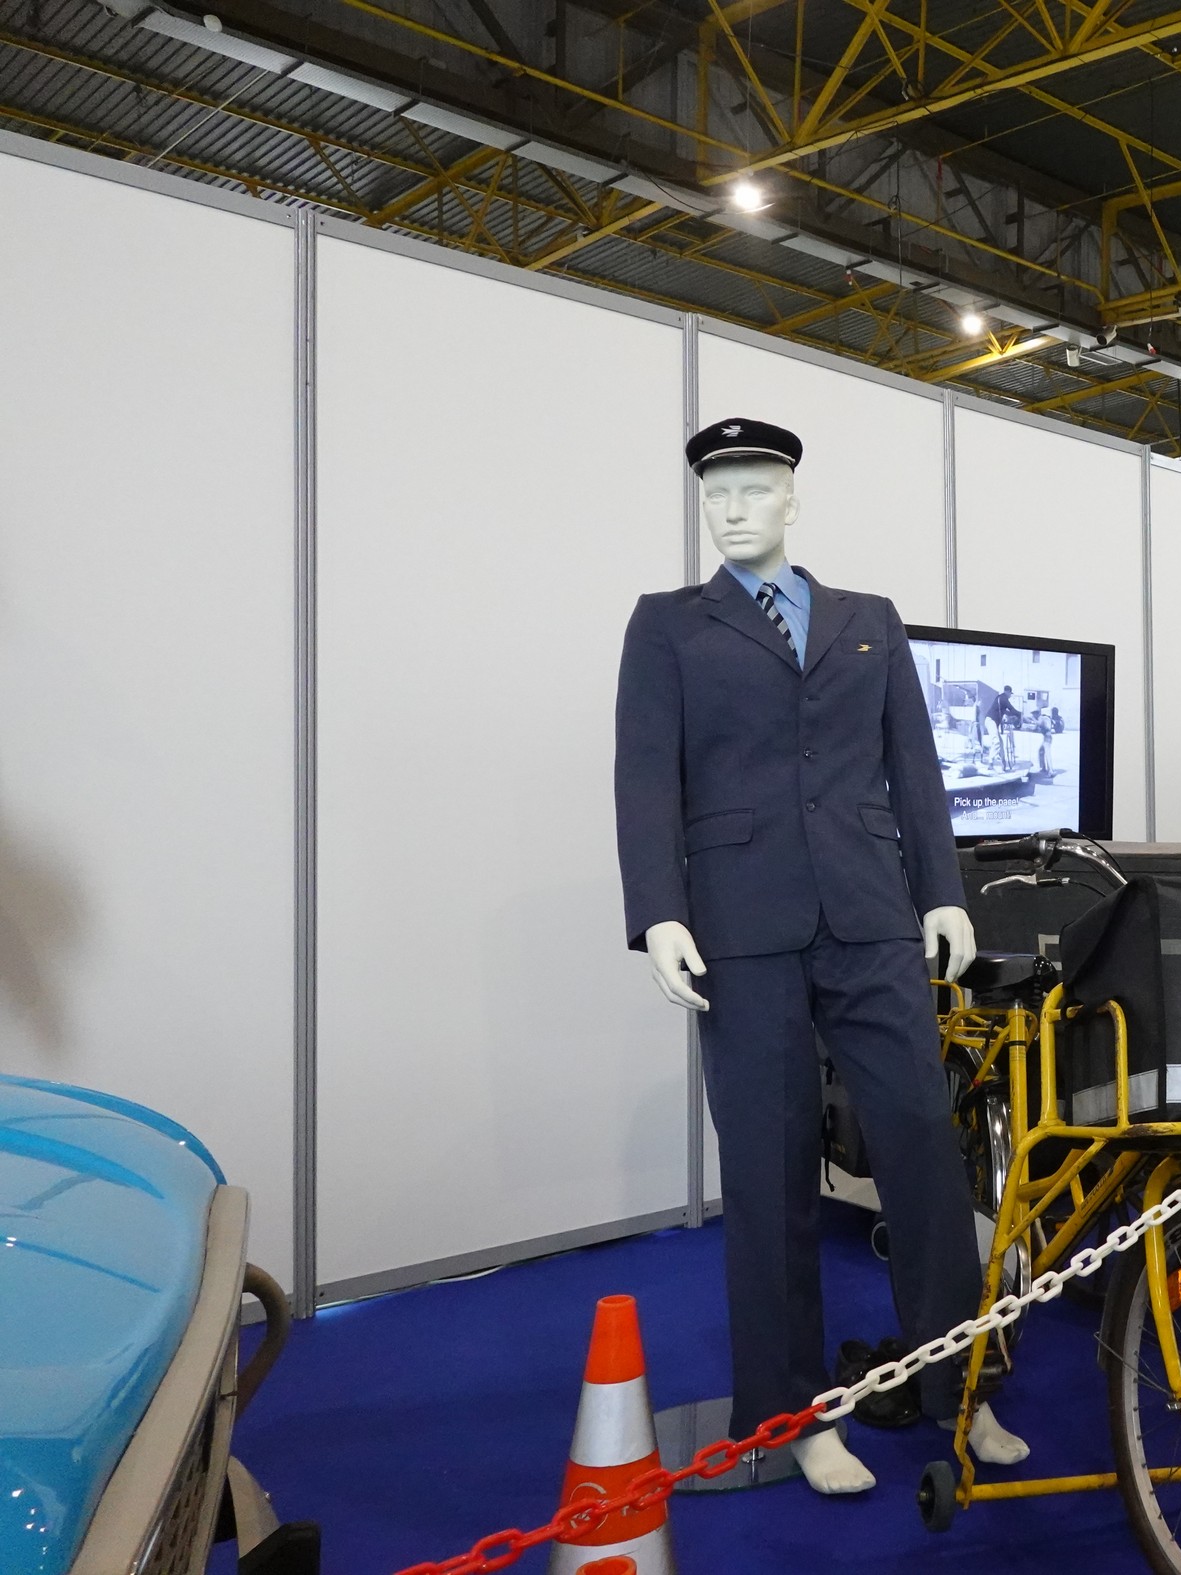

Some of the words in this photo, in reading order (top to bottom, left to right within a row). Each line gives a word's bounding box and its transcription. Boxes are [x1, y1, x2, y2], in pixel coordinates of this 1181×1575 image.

[954, 797, 971, 807] Pick
[973, 799, 983, 808] up
[984, 797, 996, 807] the
